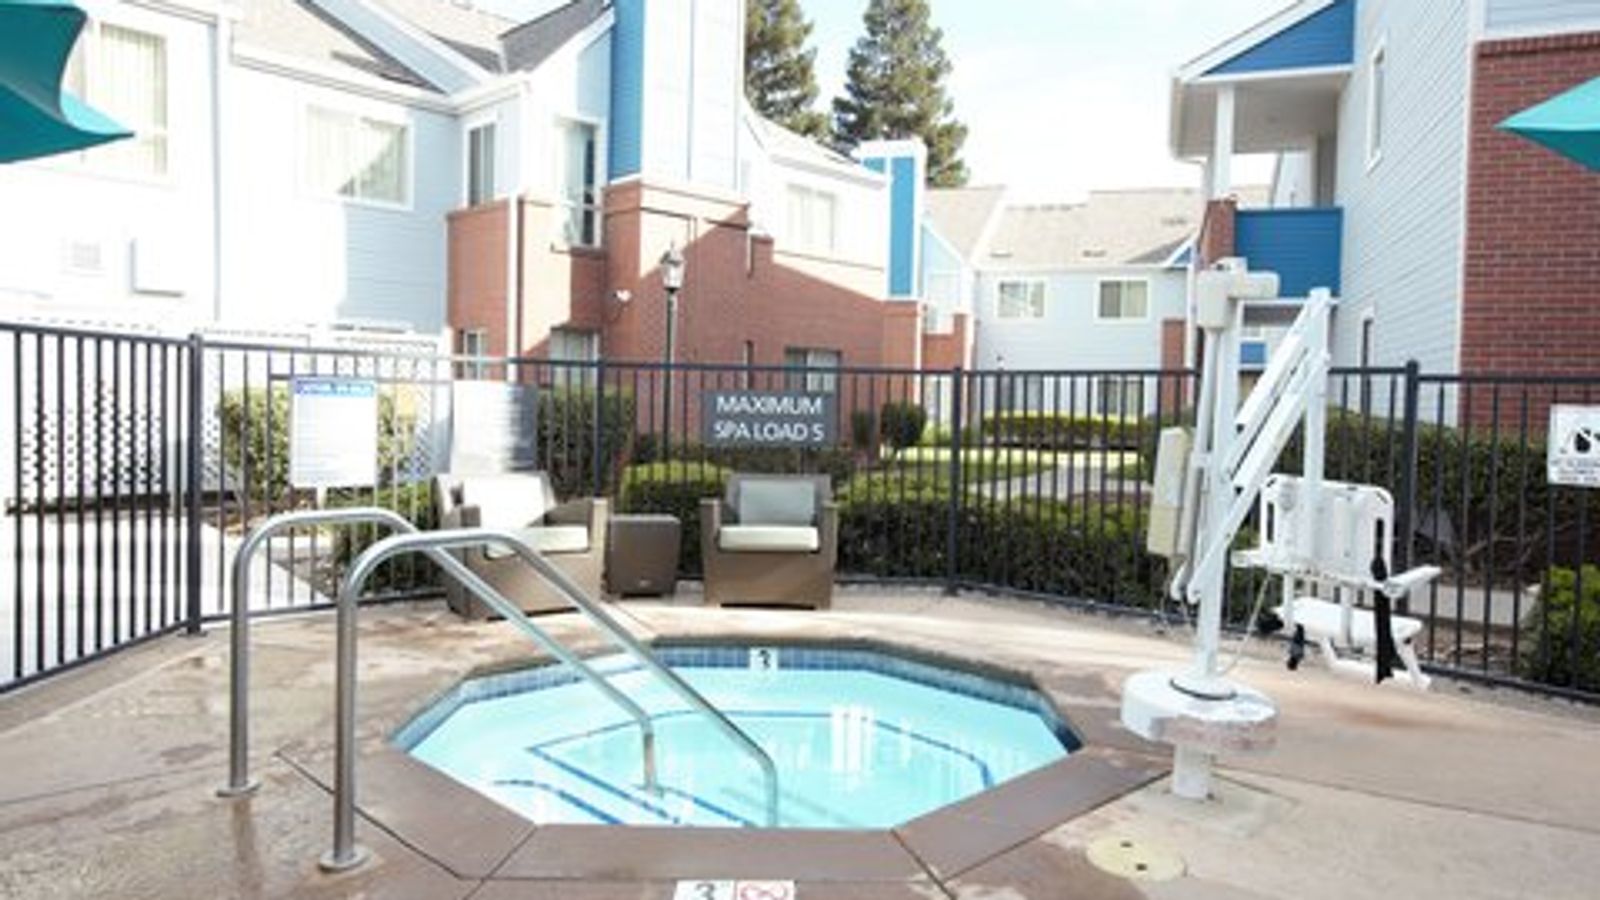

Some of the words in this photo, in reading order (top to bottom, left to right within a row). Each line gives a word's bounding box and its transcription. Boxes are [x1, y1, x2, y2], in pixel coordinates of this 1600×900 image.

[716, 395, 823, 415] MAXIMUM
[713, 420, 751, 440] SPA
[753, 422, 808, 442] LOAD
